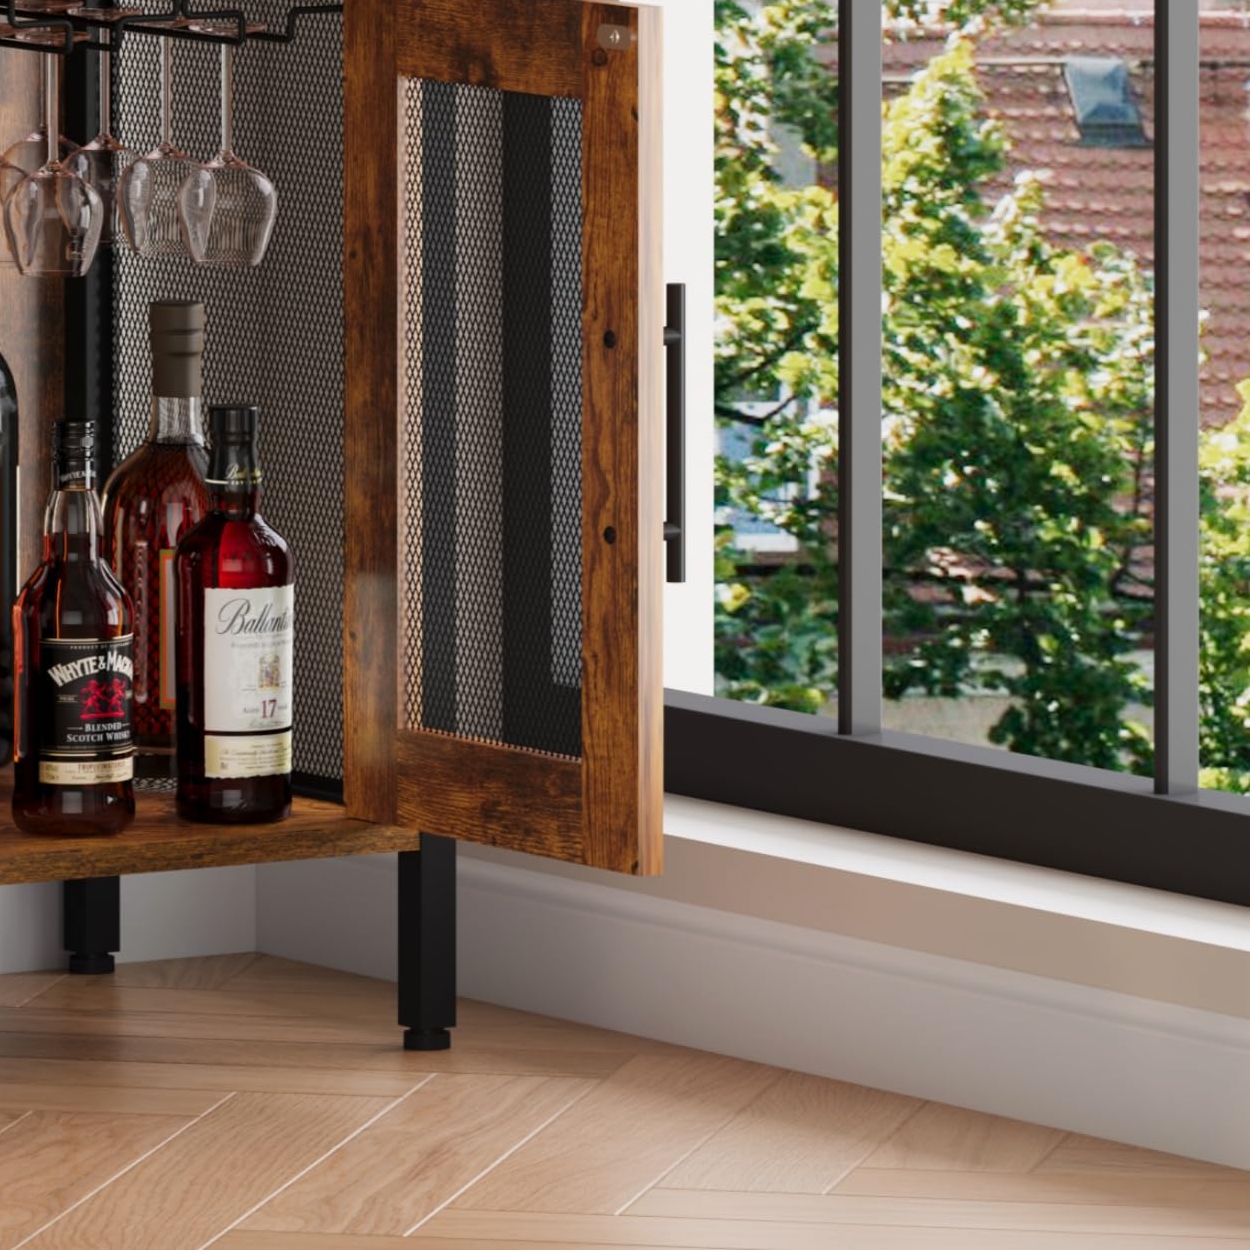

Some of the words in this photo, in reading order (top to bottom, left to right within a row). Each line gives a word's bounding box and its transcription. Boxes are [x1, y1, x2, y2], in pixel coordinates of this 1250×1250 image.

[48, 656, 98, 687] WHYTE
[262, 699, 277, 719] 17
[85, 722, 122, 733] BLENDED
[66, 733, 103, 743] SCOTCH
